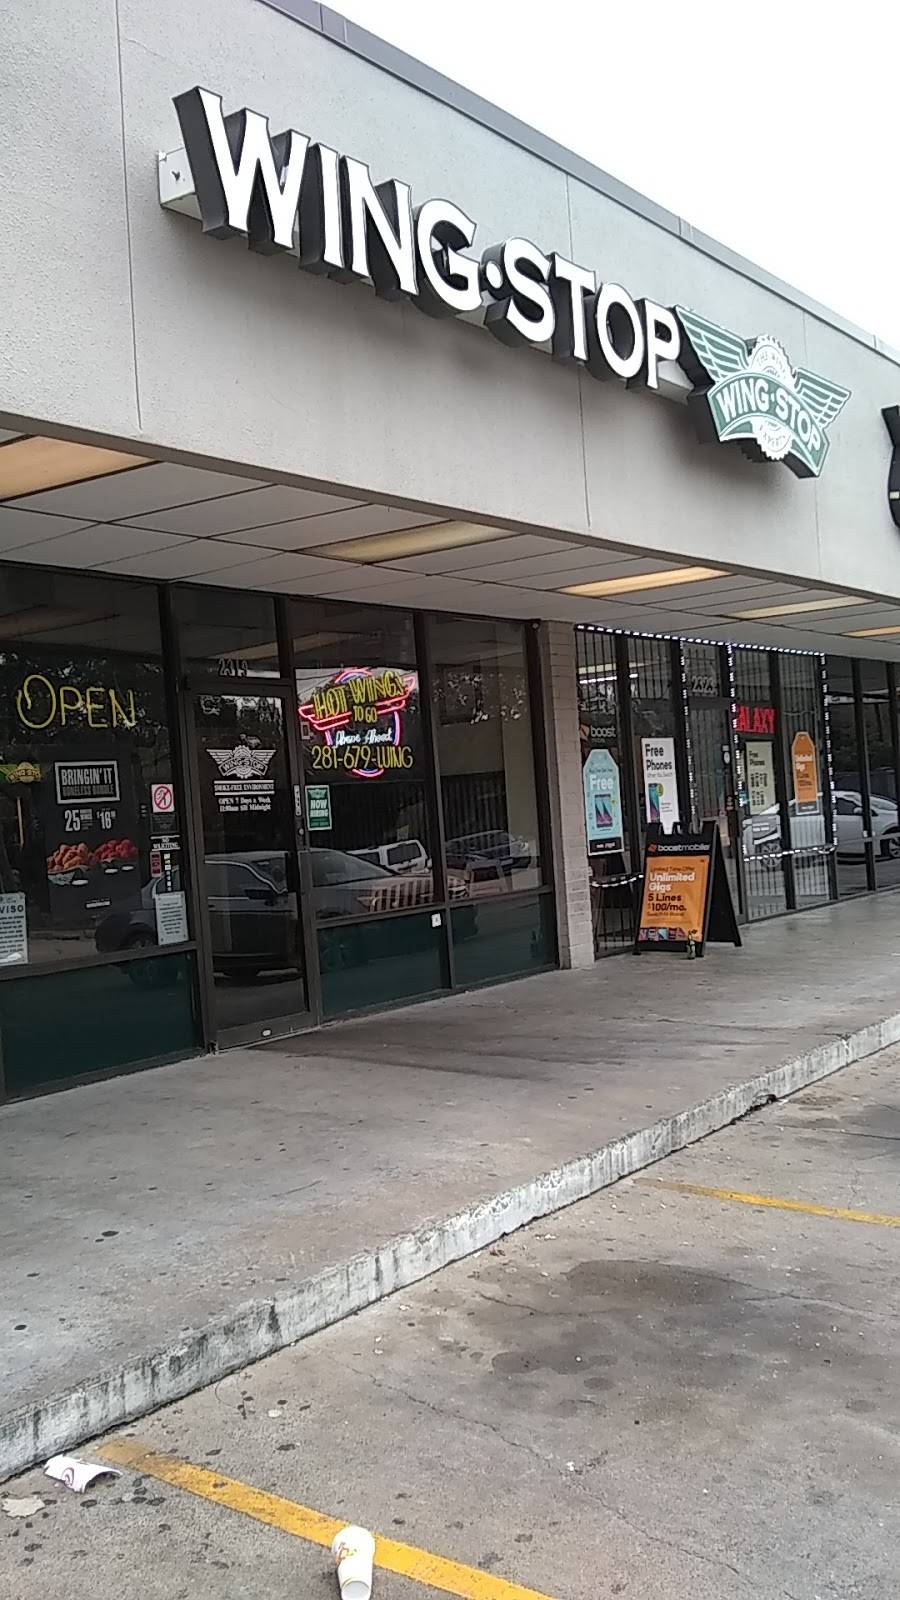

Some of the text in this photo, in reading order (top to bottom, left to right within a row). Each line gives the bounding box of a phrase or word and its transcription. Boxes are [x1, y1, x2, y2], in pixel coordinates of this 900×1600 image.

[16, 673, 138, 729] OPEN
[313, 685, 348, 720] HOT
[352, 704, 378, 723] TO GO
[590, 724, 617, 738] boost
[645, 743, 664, 757] Free
[646, 758, 673, 771] Phones
[589, 774, 614, 791] Free
[310, 799, 328, 810] NOW
[64, 809, 81, 832] 25
[649, 871, 695, 882] Unlimited
[648, 882, 672, 894] Gigs
[647, 893, 682, 902] 5 Lines
[0, 904, 24, 913] VISO
